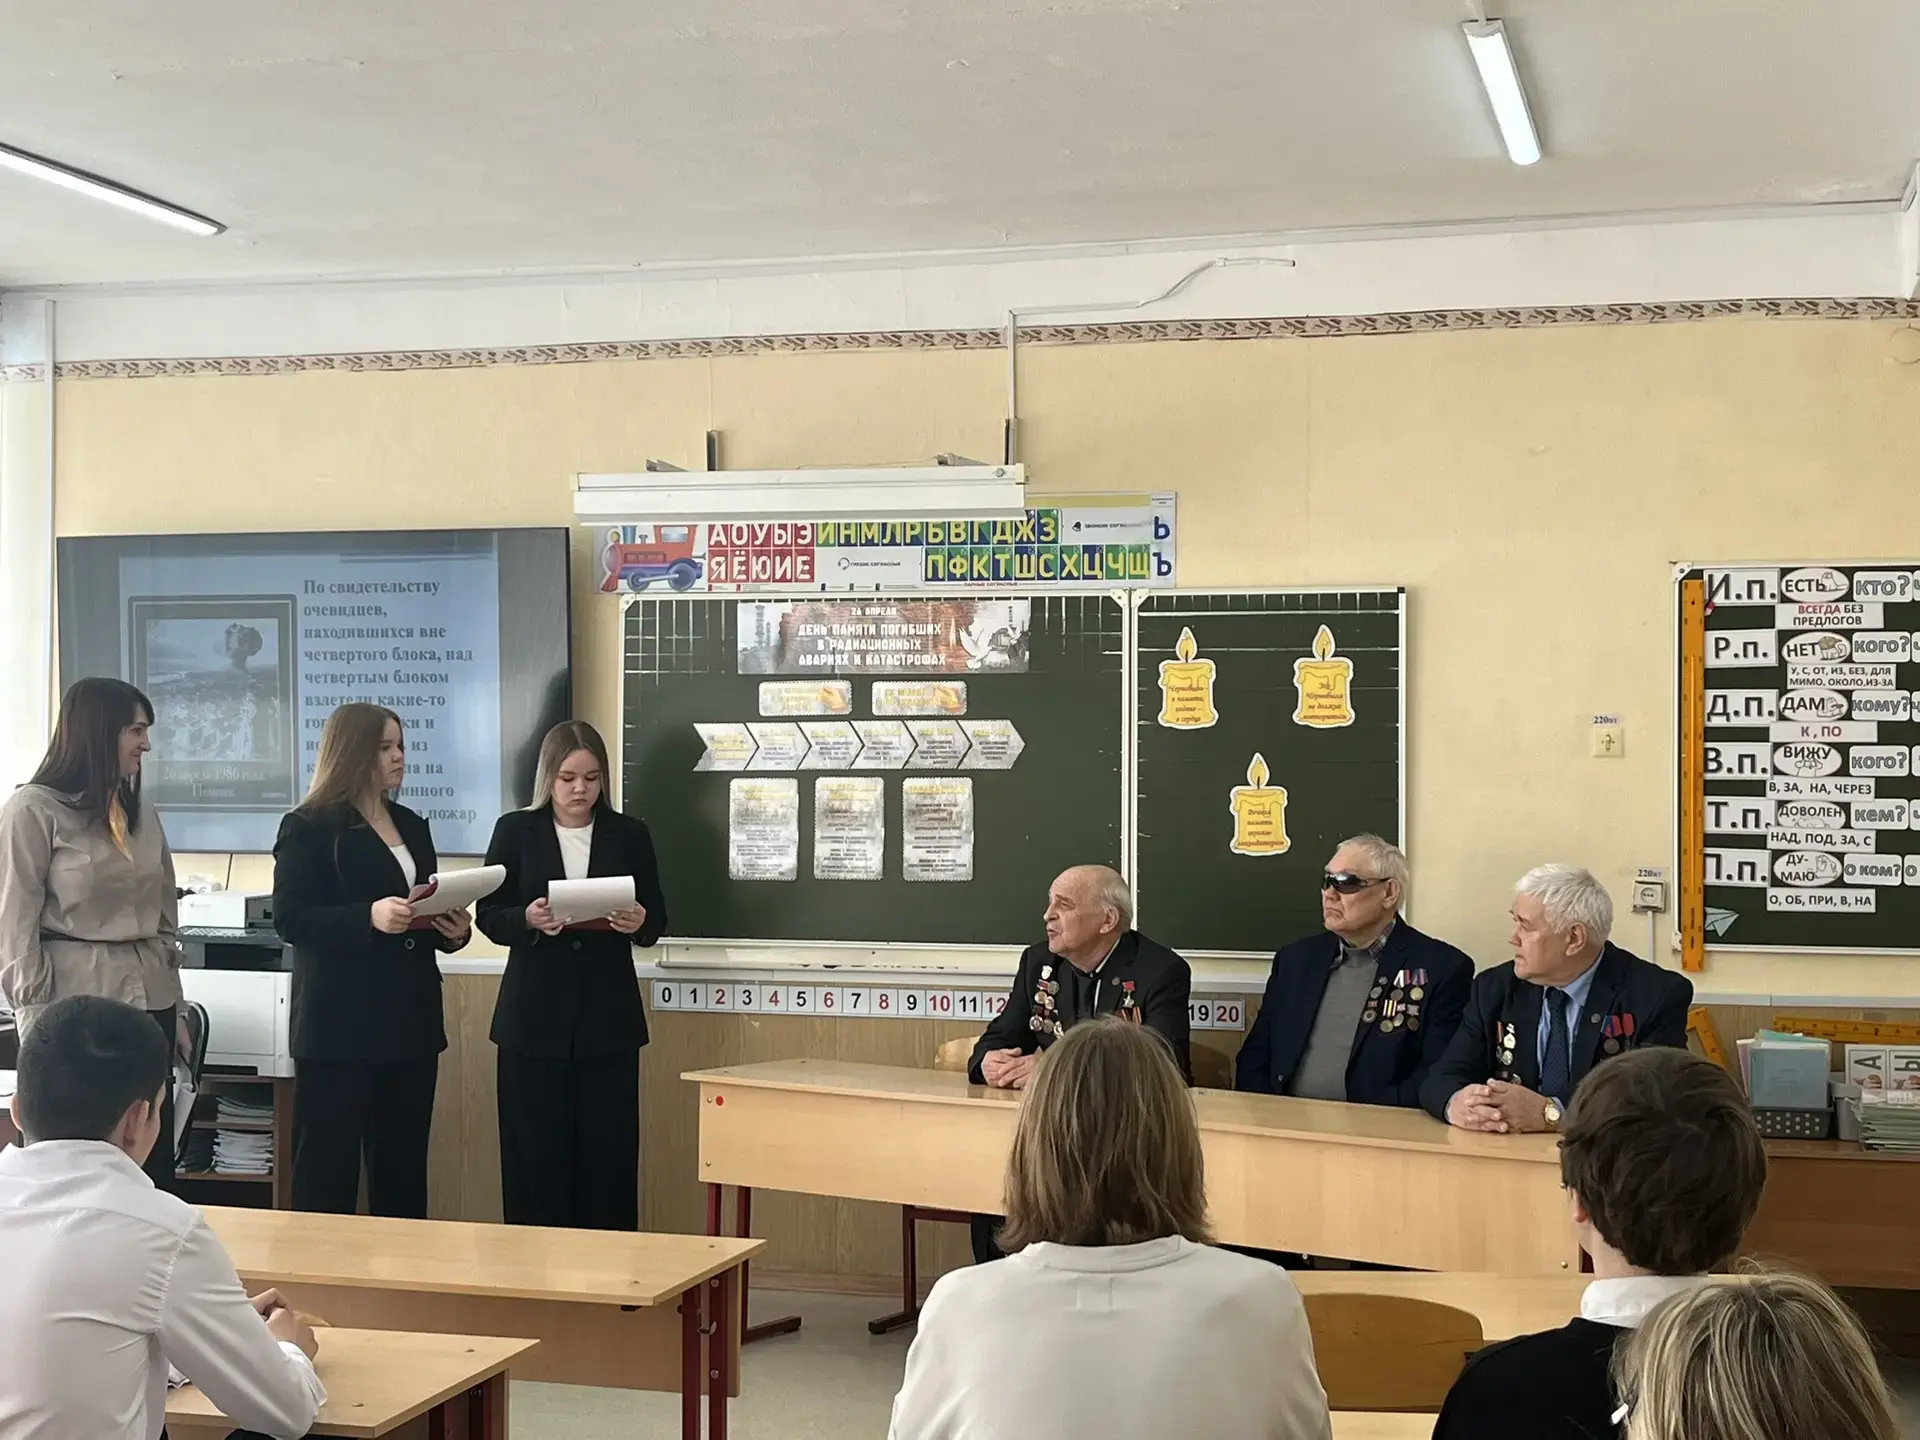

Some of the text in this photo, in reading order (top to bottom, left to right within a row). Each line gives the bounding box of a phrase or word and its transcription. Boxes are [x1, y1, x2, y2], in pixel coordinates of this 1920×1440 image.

[304, 580, 440, 596] По свидетельству
[1708, 574, 1777, 600] И.п.
[1785, 578, 1826, 593] ЕСТЬ
[304, 604, 387, 617] очевидцев,
[851, 606, 862, 616] 26
[1798, 604, 1864, 615] ВСЕГДА БЕЗ
[1793, 616, 1862, 627] ПРЕДЛОГОВ
[304, 627, 446, 640] находившихся вне
[798, 623, 942, 636] ДЕНЬ ПАМЯТИ ПОГИБШИХ
[817, 638, 921, 651] В РАДИАЦИОННЫХ
[1714, 637, 1768, 659] Р.п.
[1787, 642, 1819, 658] НЕТ
[1854, 636, 1910, 653] кого?
[304, 647, 473, 664] четвертого блока, над
[798, 653, 946, 666] АВАРИЯХ И КАТАСТРОФАХ
[305, 669, 449, 686] четвертым блоком
[1813, 667, 1829, 676] ОТ,
[1831, 667, 1847, 676] ИЗ,
[1849, 667, 1868, 676] БЕЗ,
[1871, 667, 1891, 676] ДЛЯ
[1790, 678, 1826, 687] МИМО,
[378, 695, 446, 706] какие-то
[1707, 694, 1775, 722] Д.п.
[1782, 697, 1825, 713] ДАМ
[1821, 726, 1842, 737] ПО
[412, 741, 428, 750] из
[1705, 746, 1908, 774] В.п. ВИЖУ кого?
[425, 763, 443, 774] на
[1769, 783, 1872, 795] В, ЗА, НА, ЧЕРЕЗ
[429, 809, 477, 823] пожар
[1707, 802, 1771, 828] Т.п.
[1779, 806, 1842, 818] ДОВОЛЕН
[1854, 805, 1906, 823] кем?
[1770, 833, 1802, 845] НАД,
[1805, 833, 1837, 846] ПОД,
[1840, 835, 1860, 847] ЗА,
[1786, 854, 1809, 865] ДУ-
[1781, 871, 1815, 882] МАЮ
[1785, 895, 1805, 907] ОБ,
[1809, 895, 1837, 907] ПРИ,
[1840, 896, 1851, 907] В,
[1854, 896, 1872, 906] НА
[661, 987, 1007, 1014] 0 1 2 3 4 5 6 7 8 9 10 11 12
[1188, 1004, 1240, 1022] 19 20
